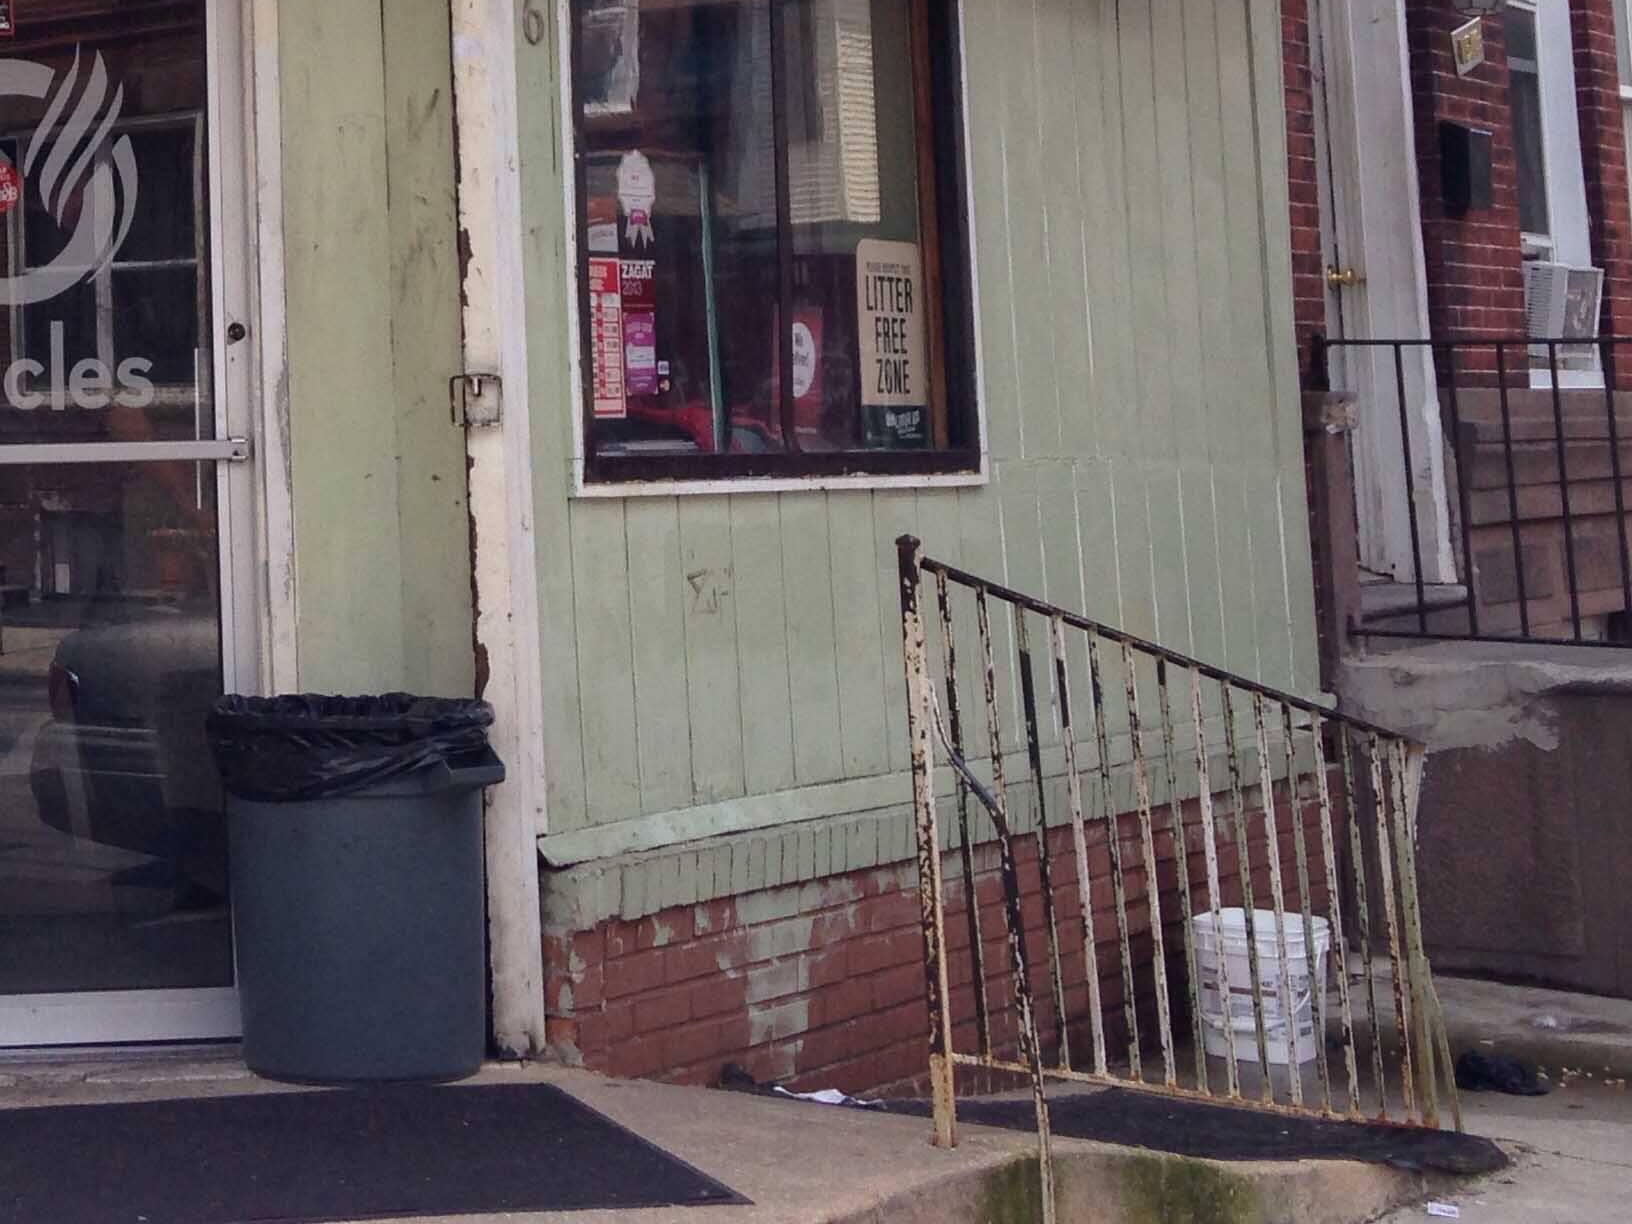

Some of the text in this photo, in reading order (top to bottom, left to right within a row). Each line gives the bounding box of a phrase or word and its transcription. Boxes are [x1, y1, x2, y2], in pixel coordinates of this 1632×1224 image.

[621, 263, 654, 280] ZAGAT
[865, 274, 914, 314] LITTER
[874, 316, 909, 355] FREE
[875, 358, 911, 395] ZONE
